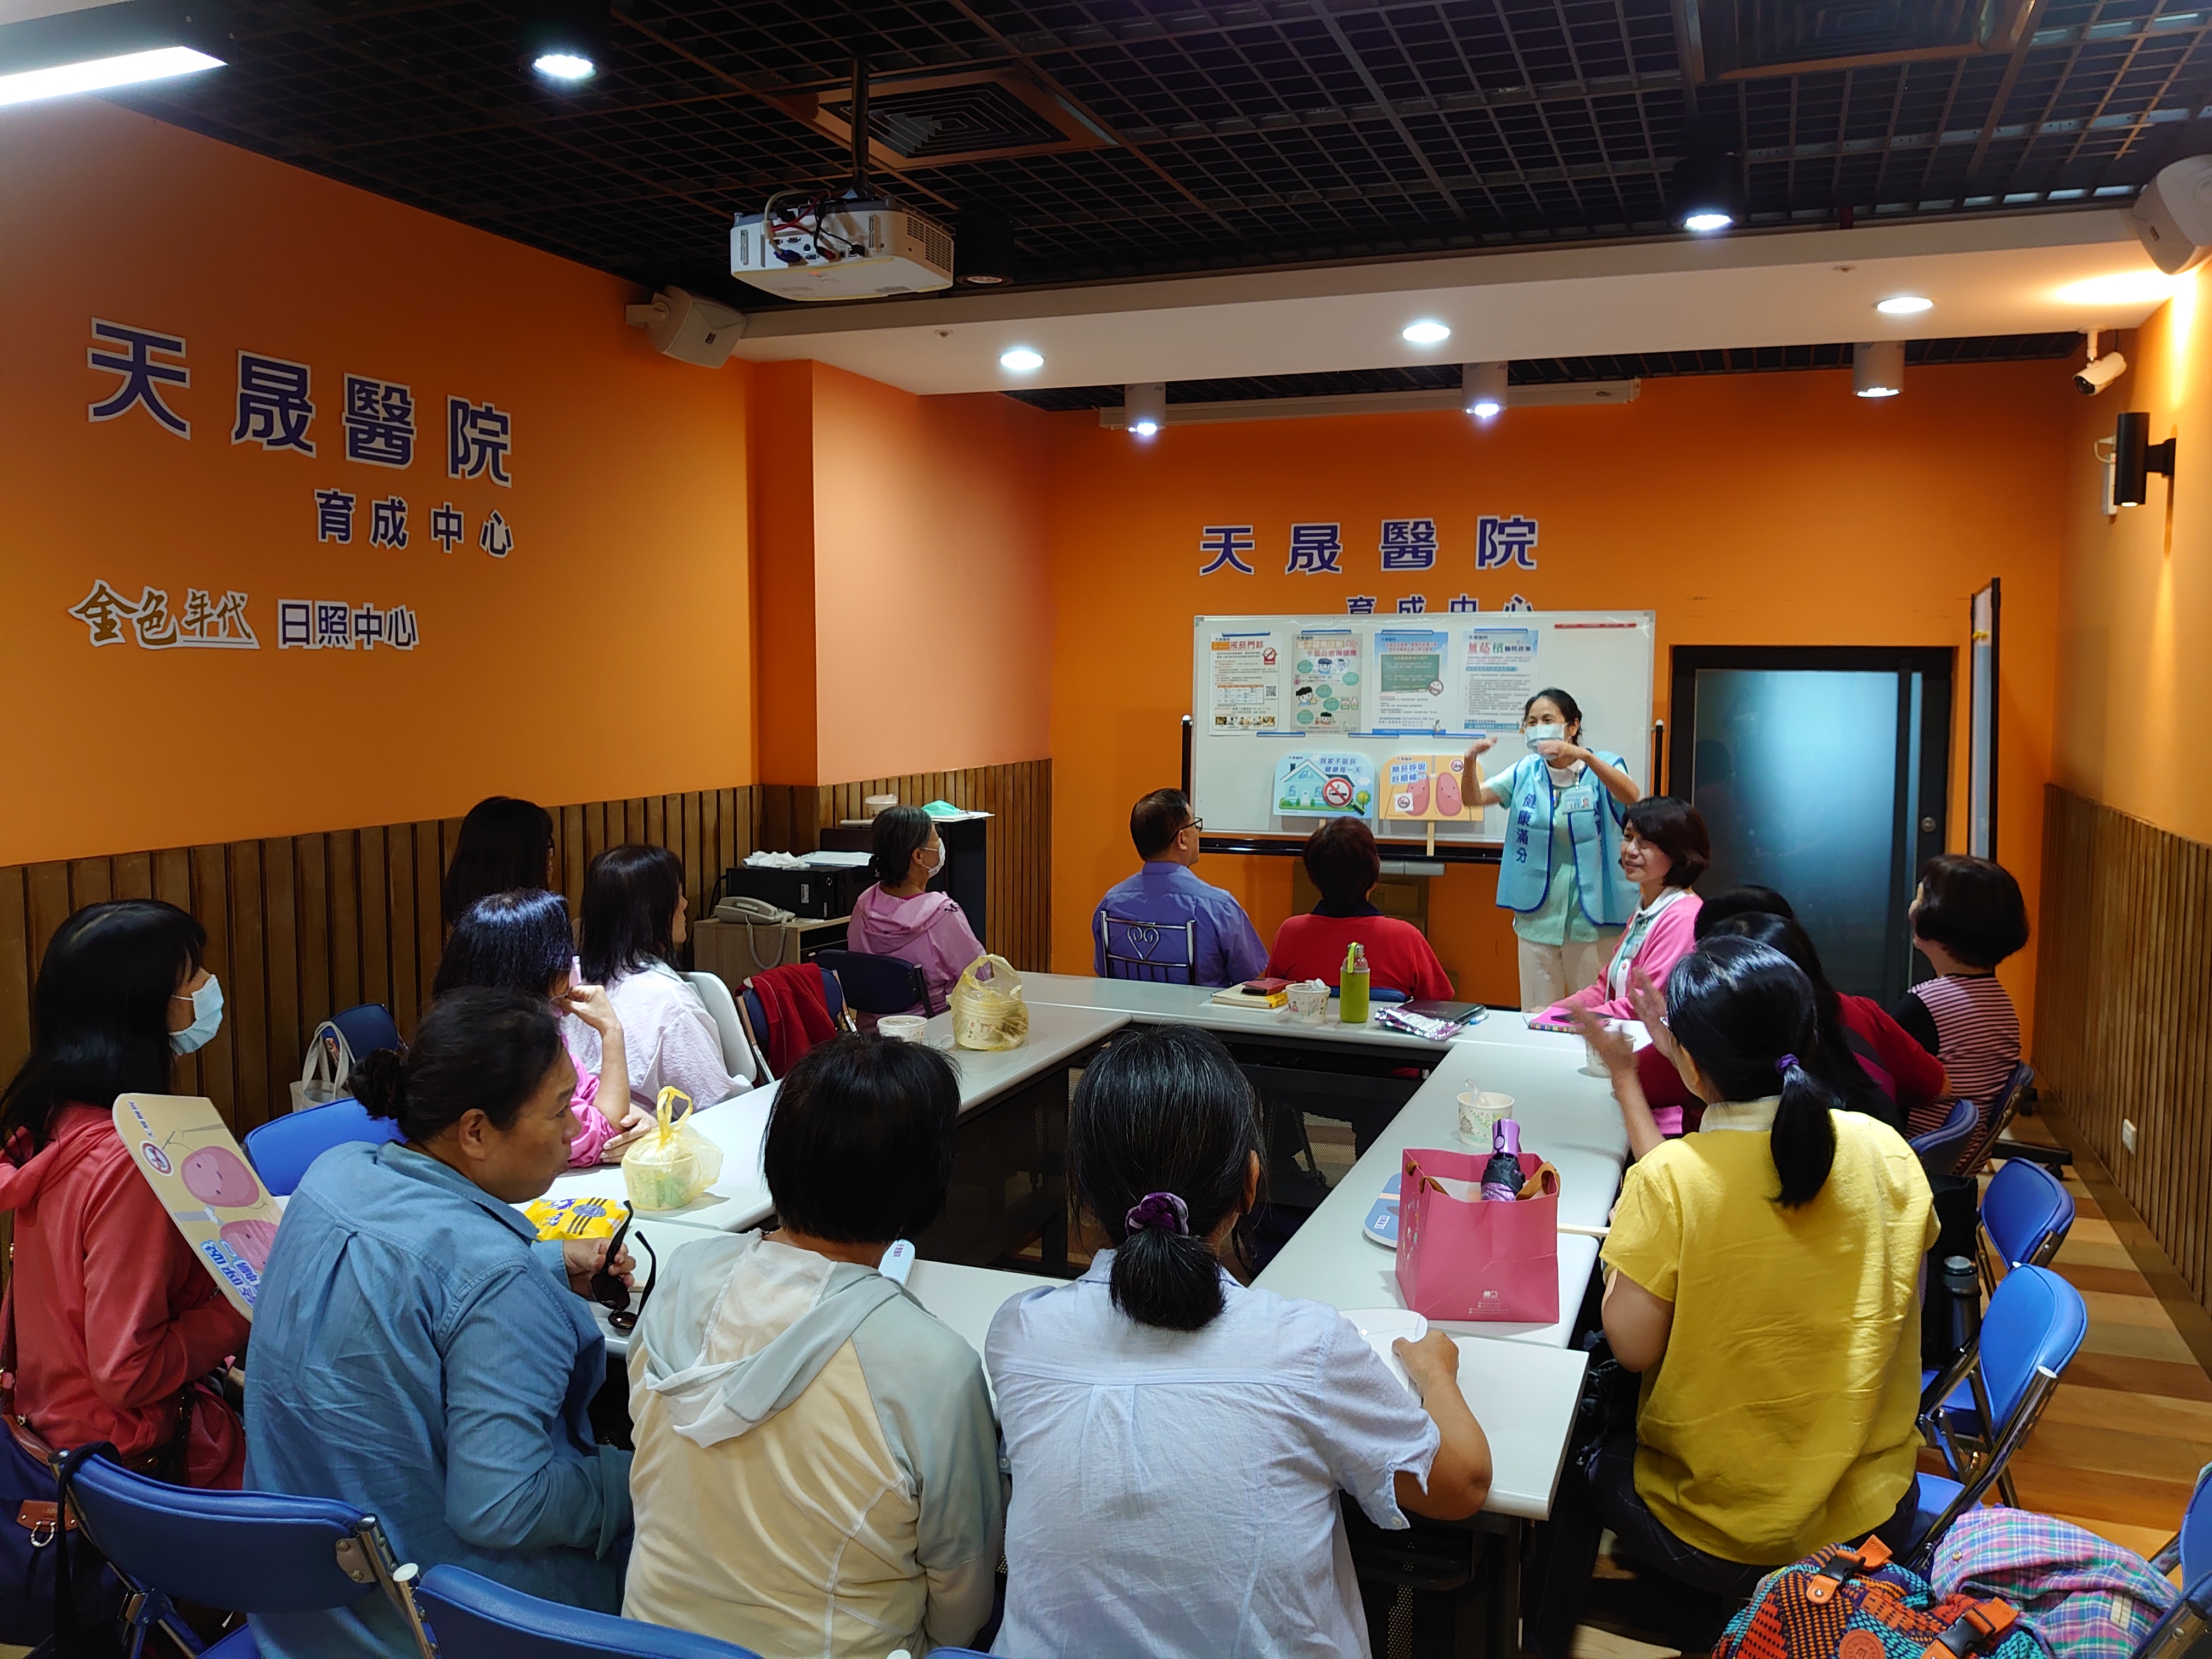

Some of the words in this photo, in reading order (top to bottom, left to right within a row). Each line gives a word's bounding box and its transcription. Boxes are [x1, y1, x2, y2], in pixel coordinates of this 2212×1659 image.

[87, 317, 513, 488] 天晟醫院
[314, 488, 514, 558] 育成中心
[1200, 515, 1538, 575] 天晟醫院
[68, 579, 261, 650] 金色年代
[277, 599, 420, 651] 日照中心
[1231, 641, 1264, 649] 戒菸門診
[1392, 763, 1426, 774] 無菸呼吸
[1515, 793, 1537, 864] 健康滿分
